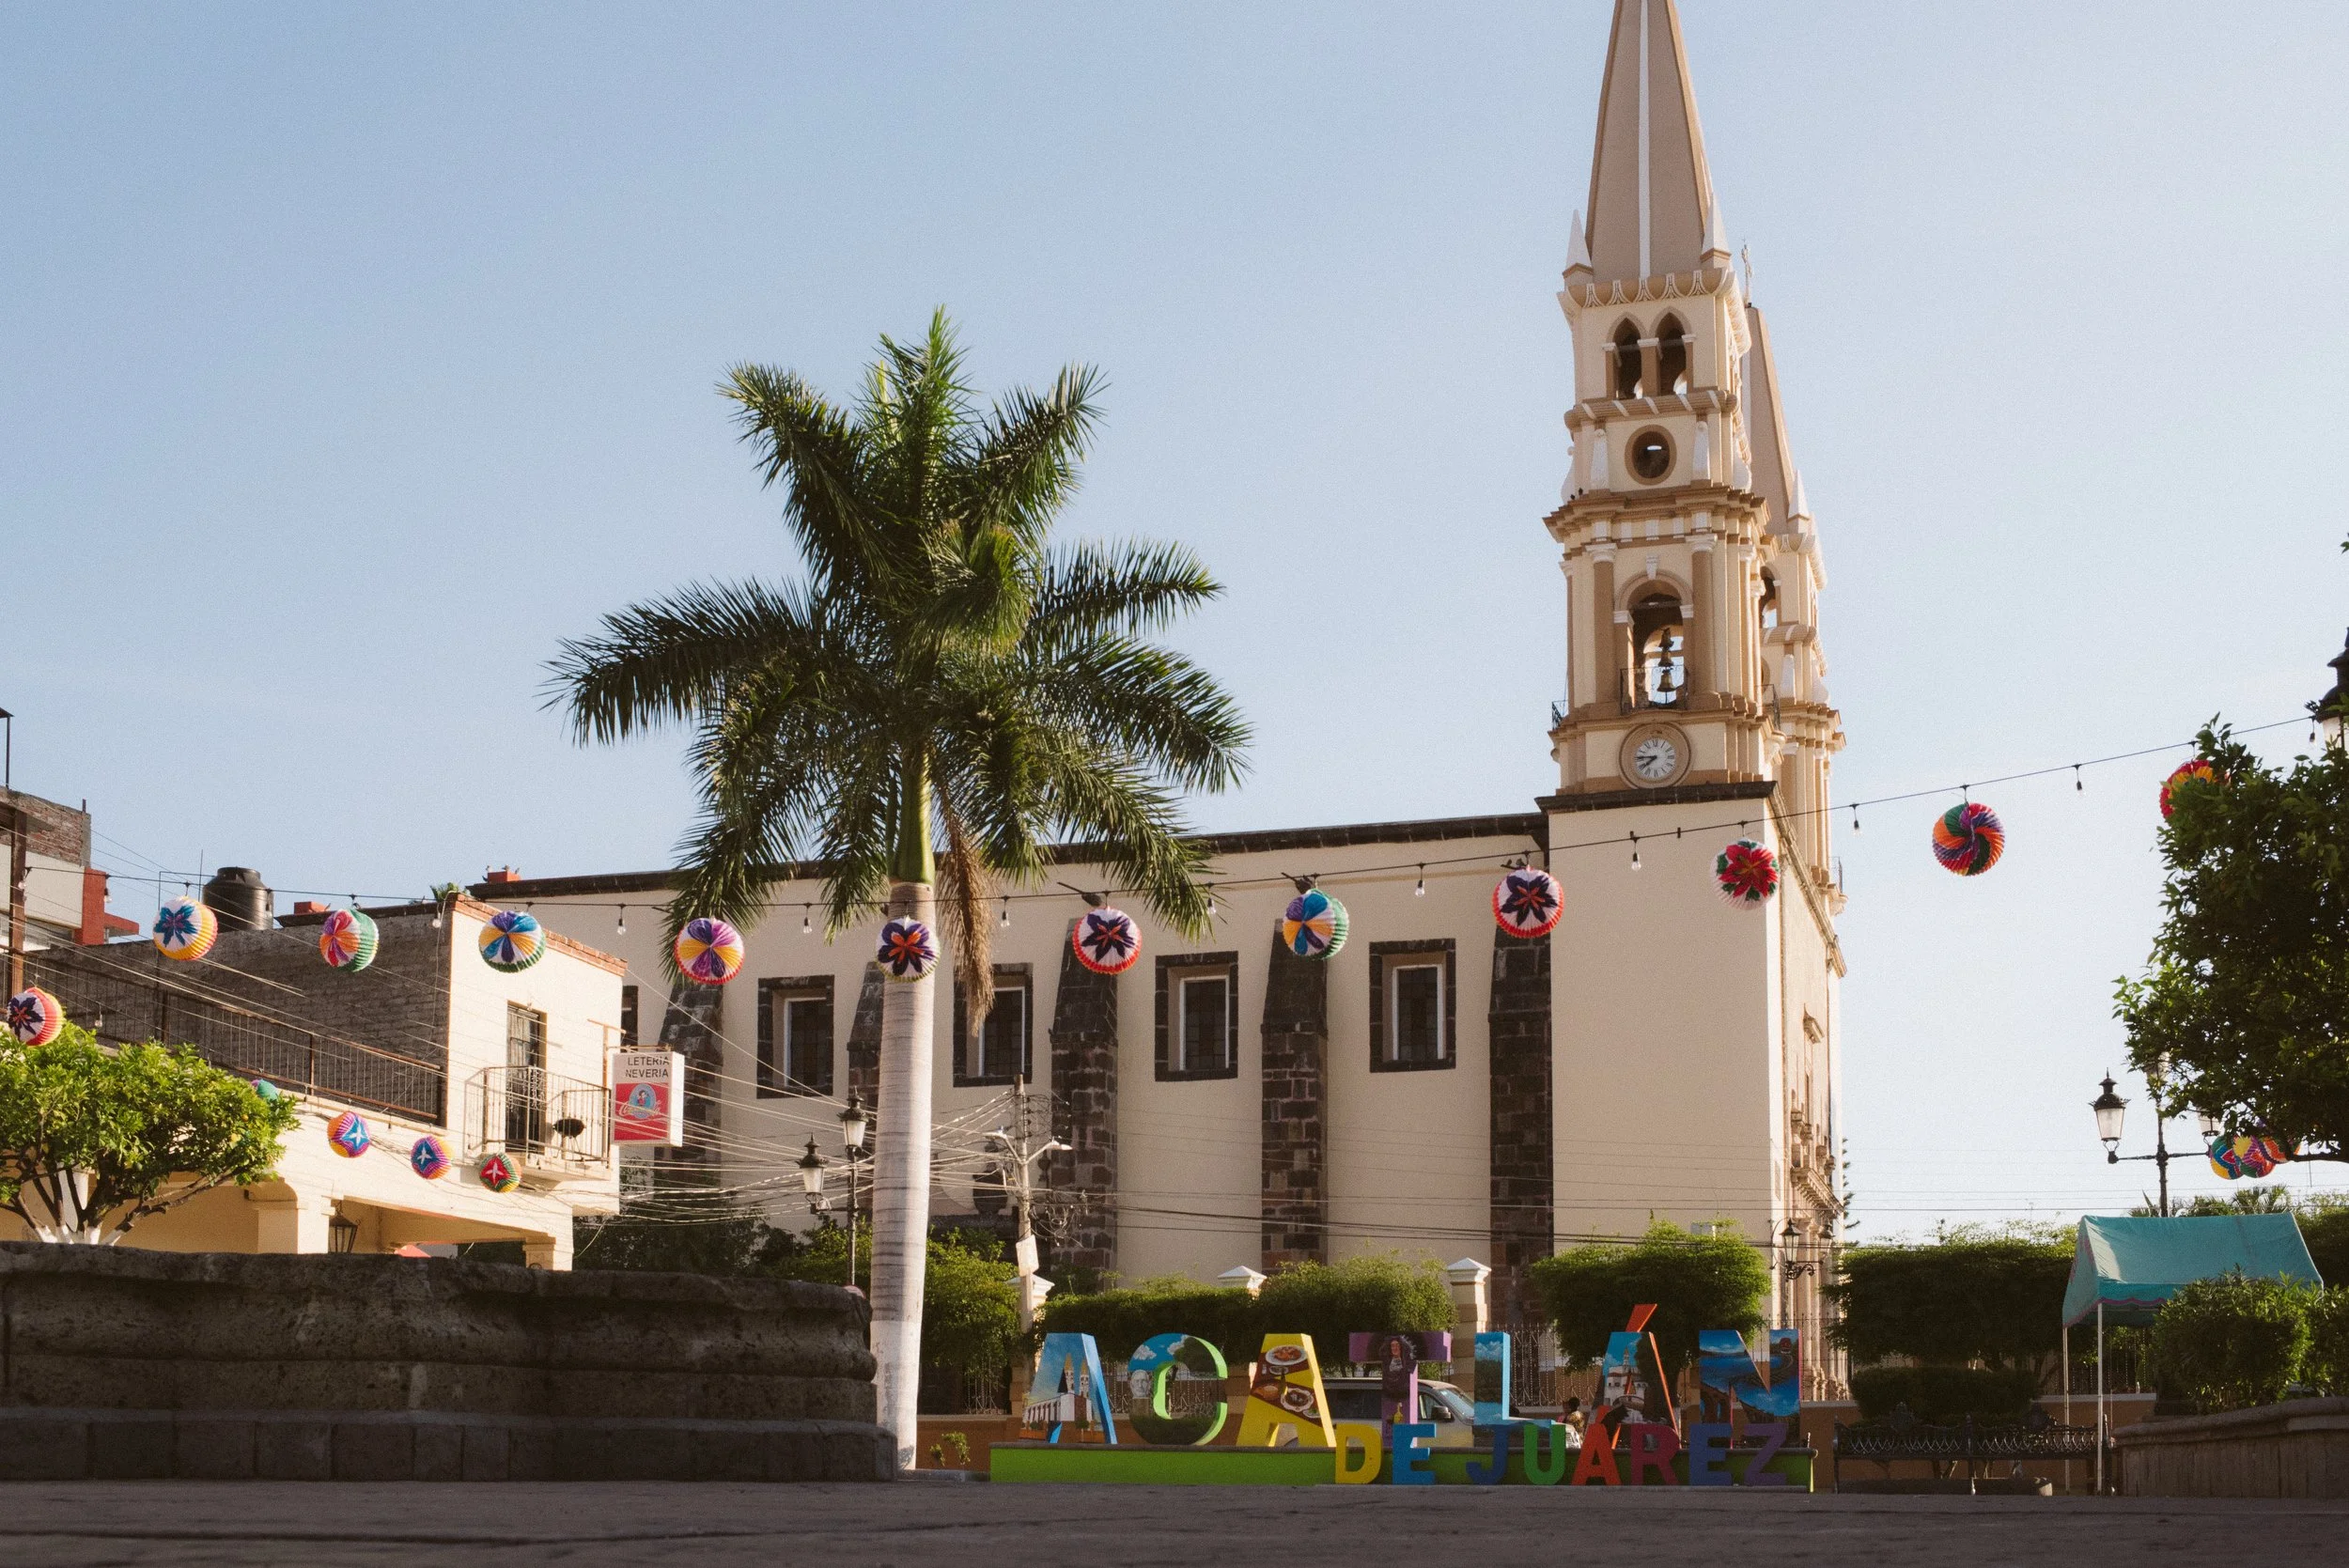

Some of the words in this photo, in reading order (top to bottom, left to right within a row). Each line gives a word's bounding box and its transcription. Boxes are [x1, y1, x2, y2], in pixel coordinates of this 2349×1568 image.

[625, 1068, 669, 1078] NEVERIA
[1020, 1303, 1800, 1449] ACATLÁN
[1334, 1422, 1438, 1485] DE
[1466, 1405, 1789, 1485] JUÁREZ
